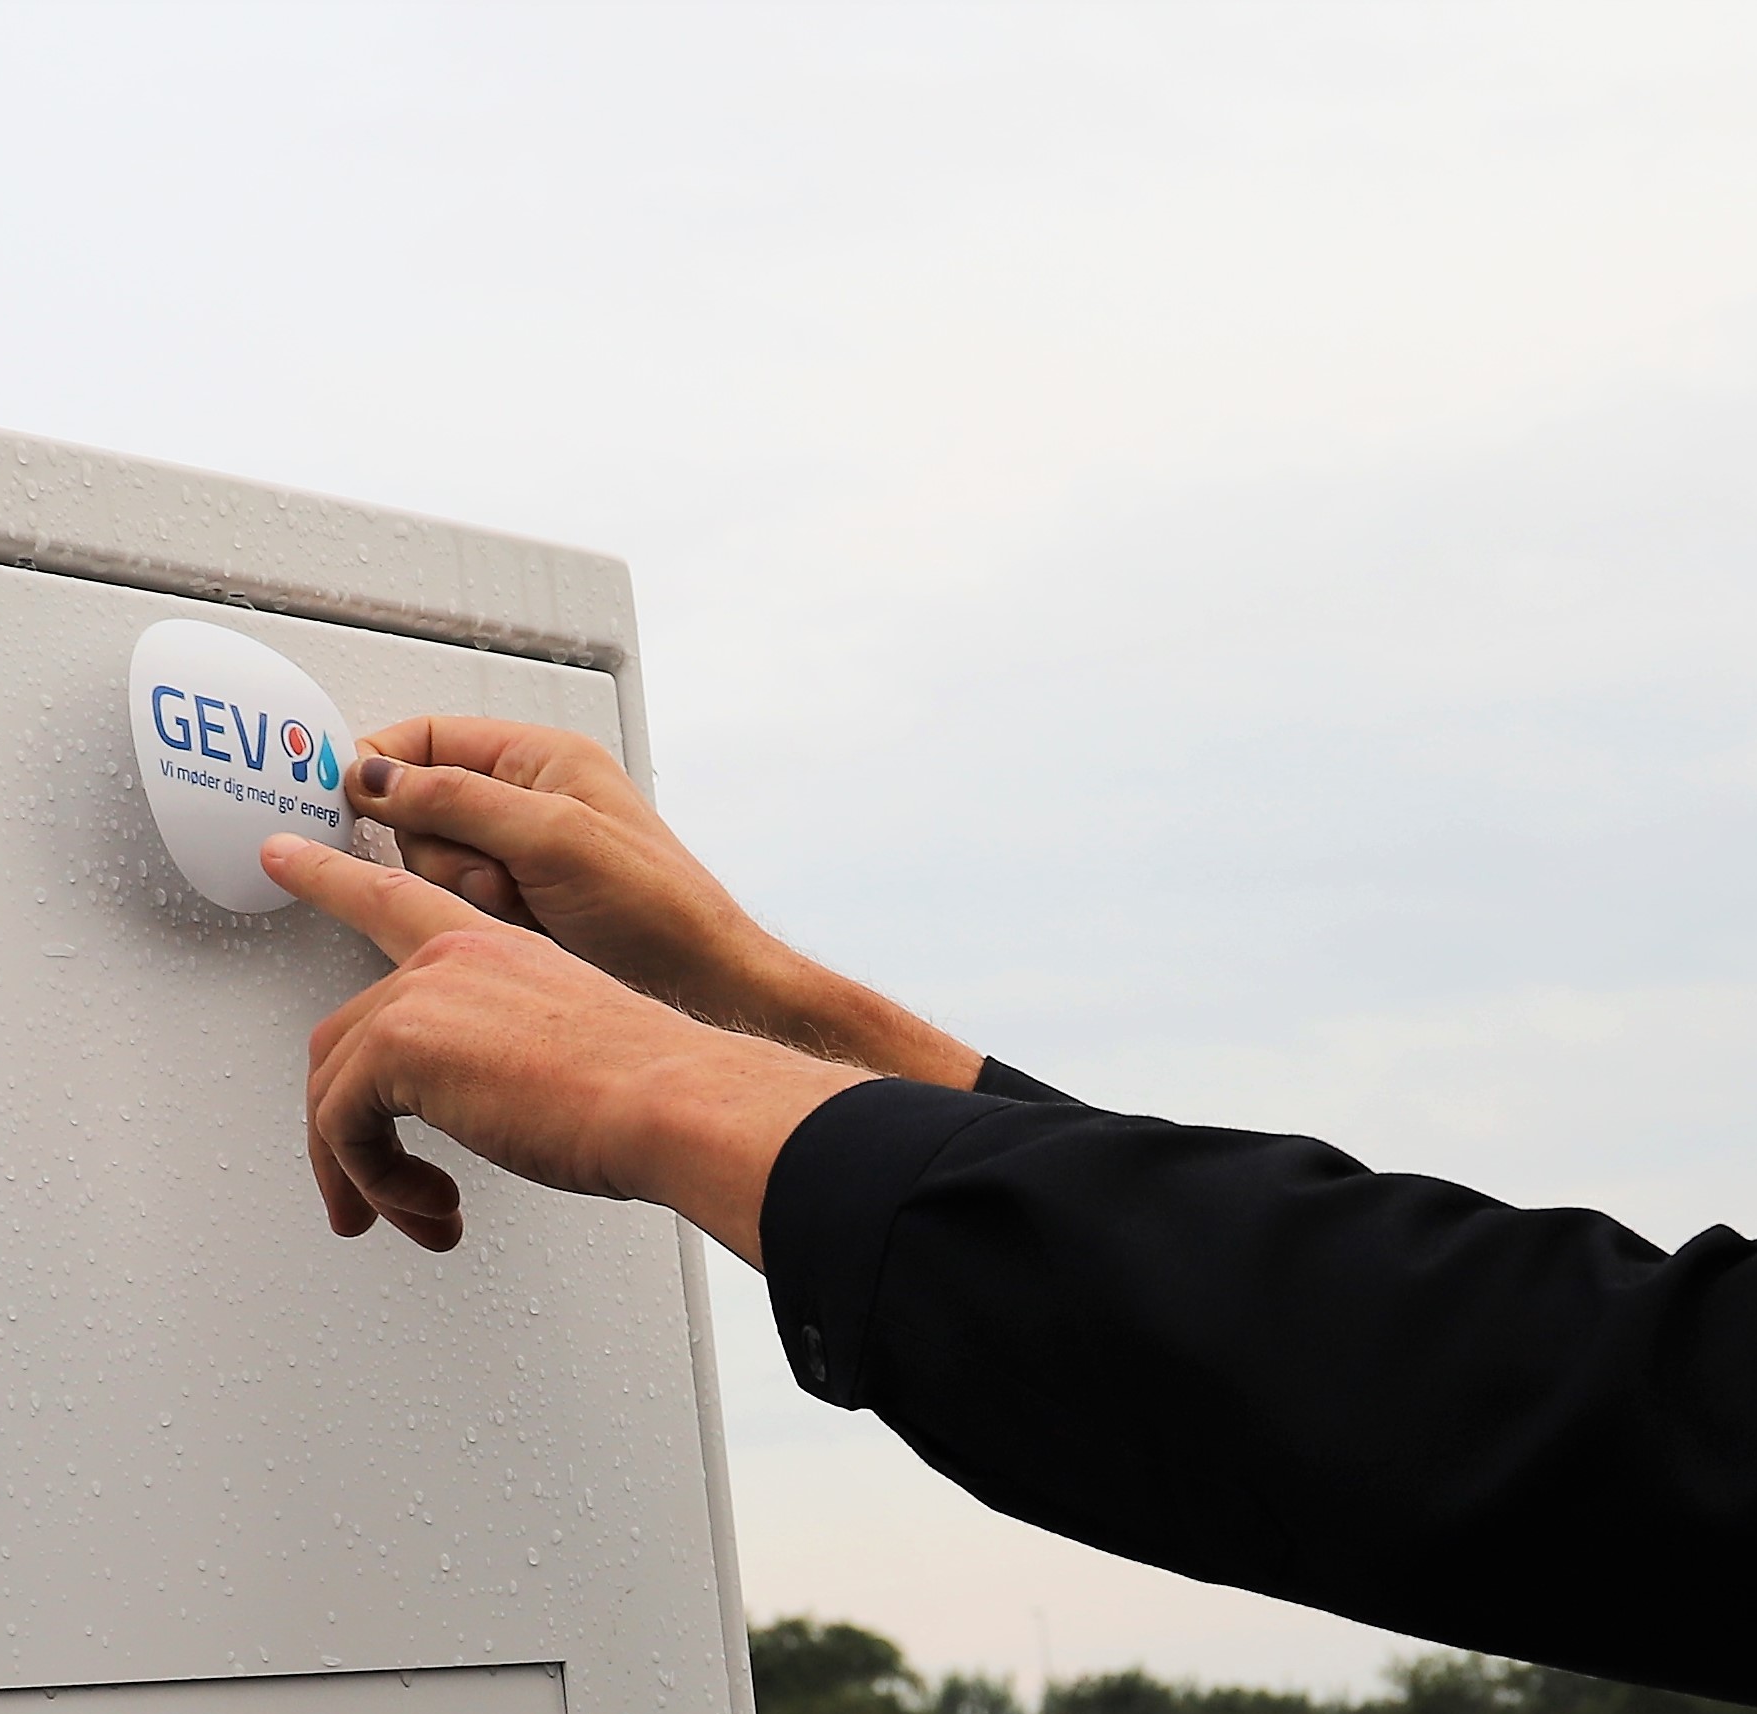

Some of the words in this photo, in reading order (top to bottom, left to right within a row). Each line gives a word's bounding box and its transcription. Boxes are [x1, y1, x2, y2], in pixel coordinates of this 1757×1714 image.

[151, 685, 268, 771] GEV
[160, 758, 174, 778] Vi
[177, 766, 221, 790] møder
[224, 777, 244, 802] dig
[247, 786, 276, 806] med
[301, 801, 340, 828] energi
